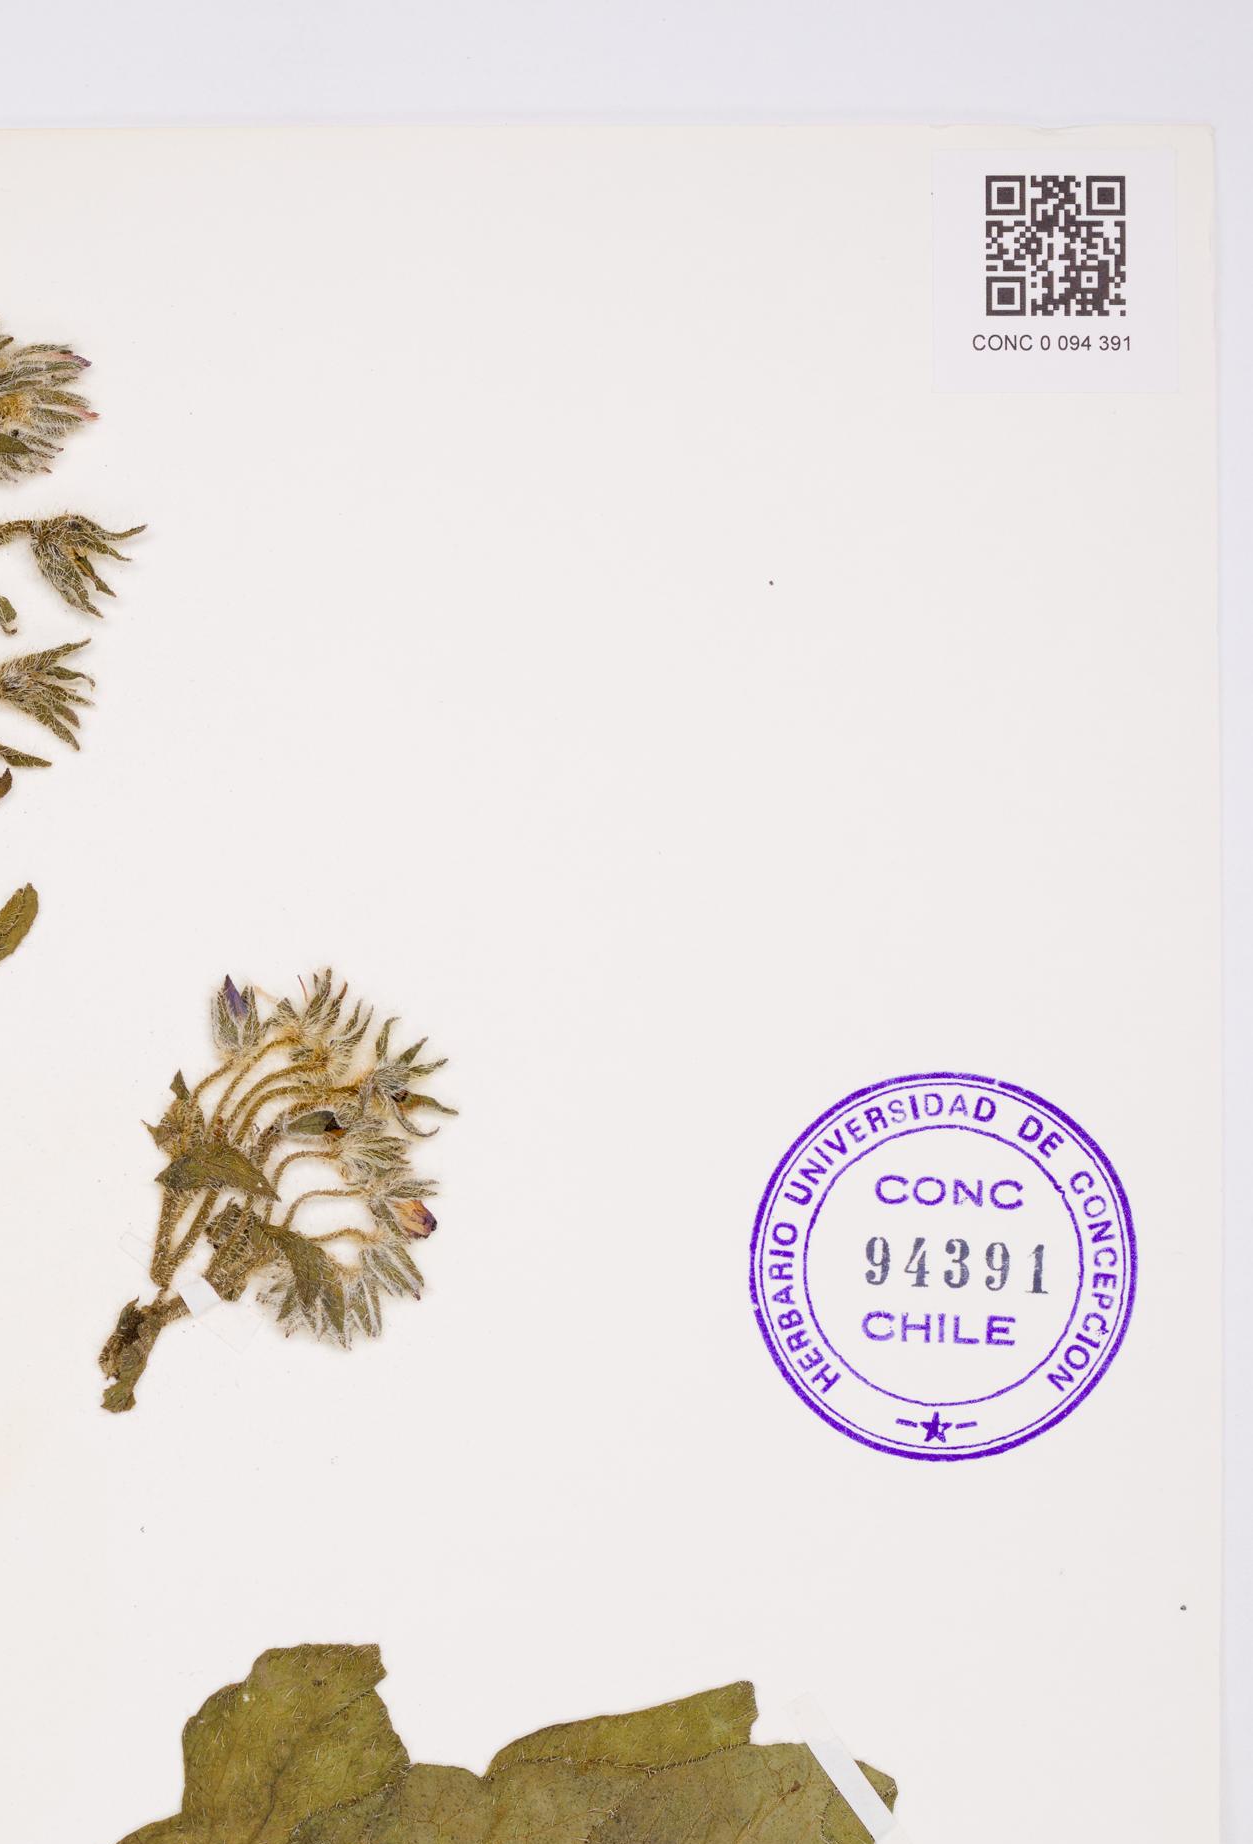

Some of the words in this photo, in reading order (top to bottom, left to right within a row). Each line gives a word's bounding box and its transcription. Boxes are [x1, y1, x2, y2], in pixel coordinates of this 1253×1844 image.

[972, 334, 1033, 352] CONC
[1040, 334, 1051, 351] 0
[1057, 335, 1092, 351] 094
[1098, 335, 1131, 352] 391
[783, 1093, 997, 1207] UNIVERSIDAD
[1017, 1114, 1065, 1160] DE
[874, 1174, 1024, 1210] CONC
[863, 1236, 1051, 1295] 94391
[1046, 1169, 1120, 1393] CONCEPCION
[768, 1220, 842, 1396] HERBARIO
[860, 1310, 1018, 1346] CHILE
